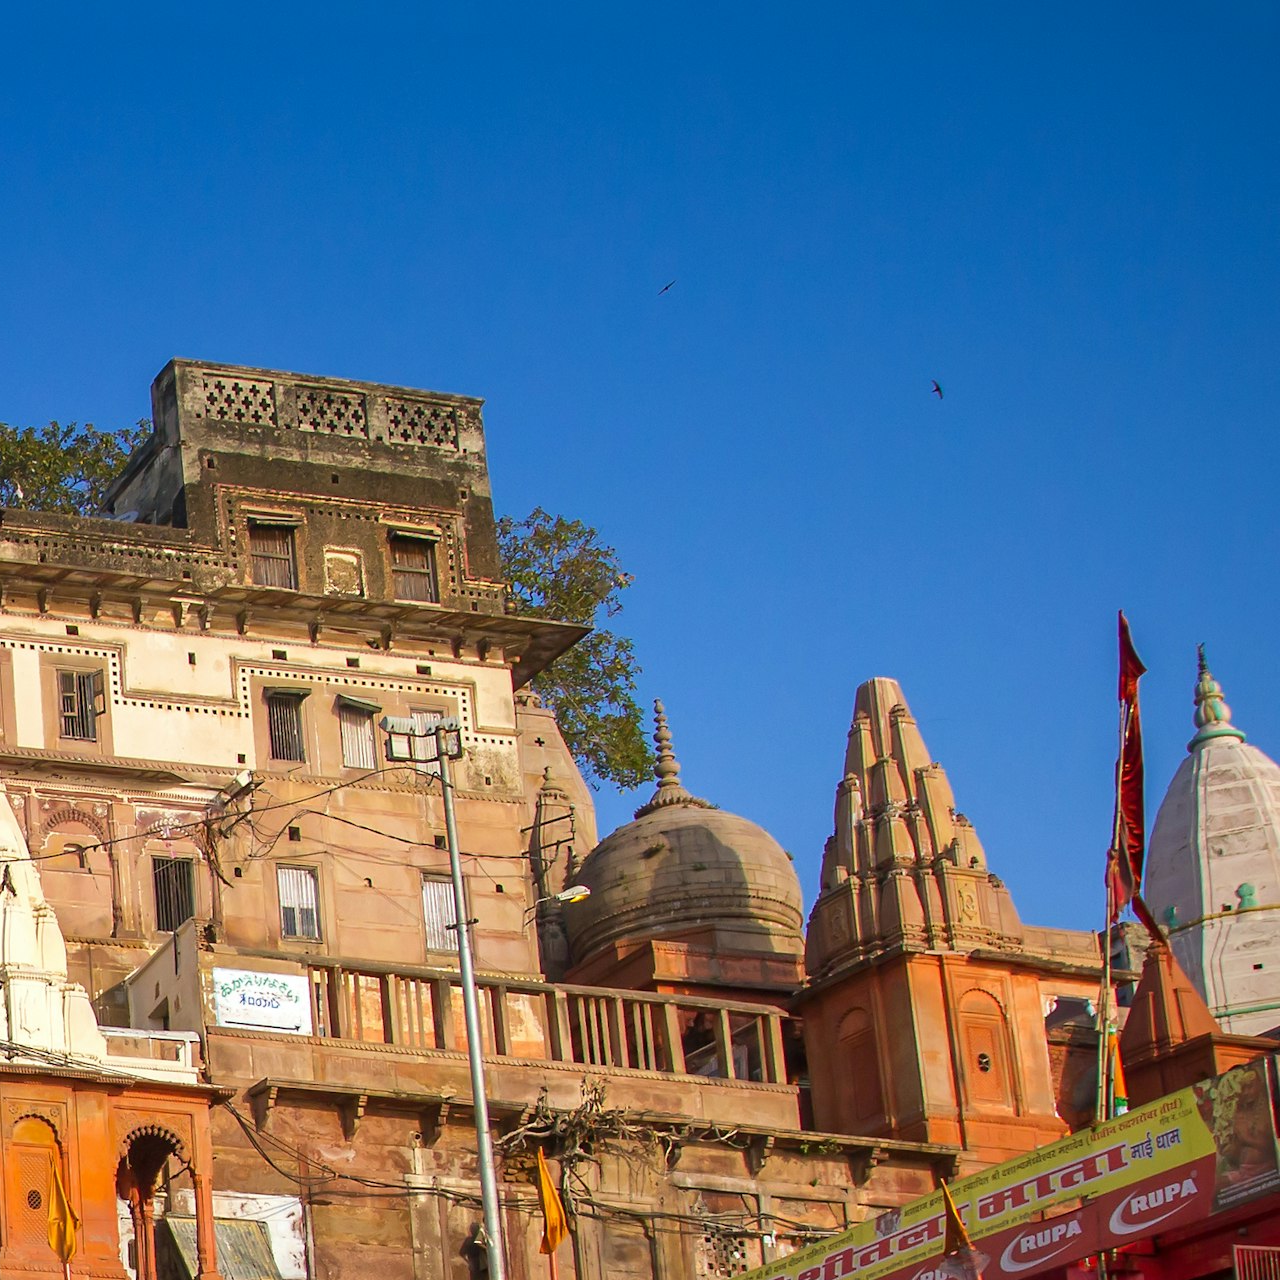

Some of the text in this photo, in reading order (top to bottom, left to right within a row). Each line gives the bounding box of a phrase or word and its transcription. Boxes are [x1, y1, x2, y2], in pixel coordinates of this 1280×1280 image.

[977, 1144, 1130, 1221] माता
[1130, 1131, 1153, 1159] माई
[1156, 1128, 1181, 1148] धाम
[1129, 1178, 1198, 1215] RUPA
[1020, 1219, 1082, 1254] RUPA
